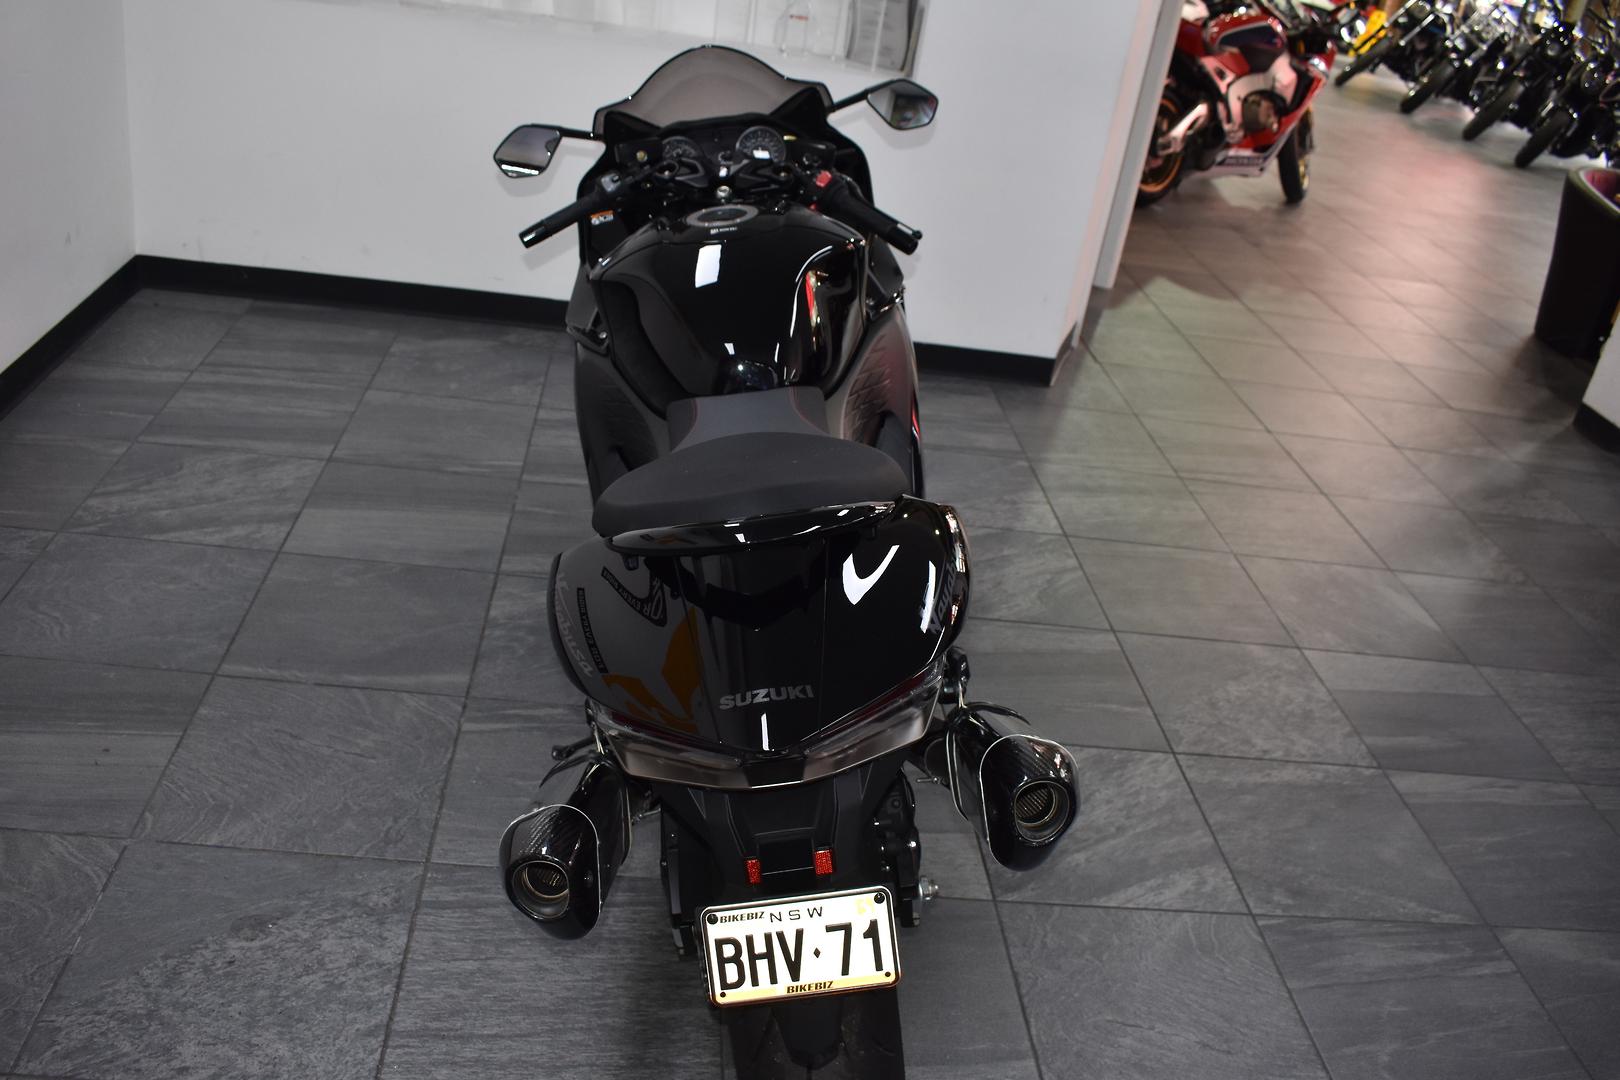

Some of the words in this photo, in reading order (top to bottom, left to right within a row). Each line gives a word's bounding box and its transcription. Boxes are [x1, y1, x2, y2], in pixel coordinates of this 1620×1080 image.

[719, 684, 815, 711] SUZUKI
[719, 911, 766, 924] BIKEBIZ
[769, 906, 823, 923] NSW
[786, 980, 834, 994] BIKEBIZ
